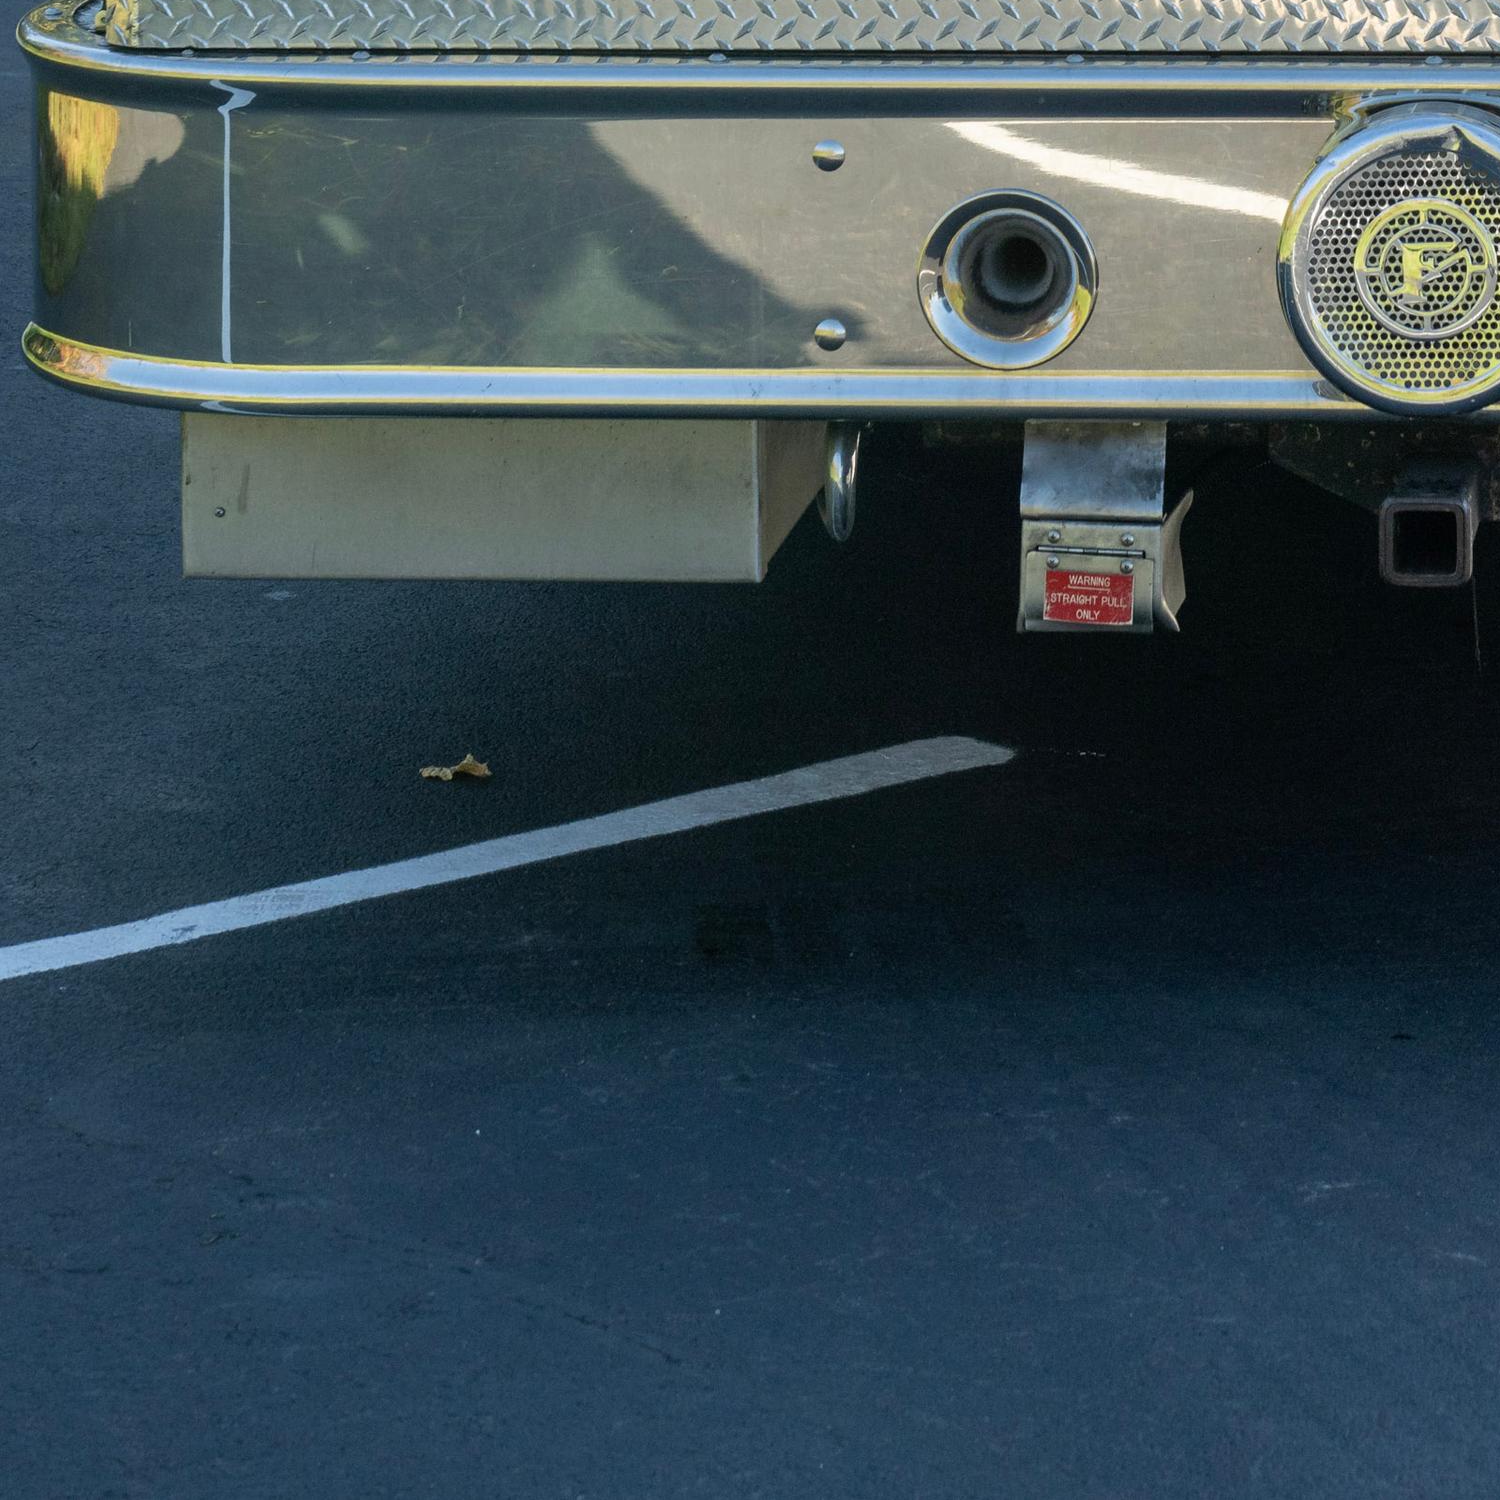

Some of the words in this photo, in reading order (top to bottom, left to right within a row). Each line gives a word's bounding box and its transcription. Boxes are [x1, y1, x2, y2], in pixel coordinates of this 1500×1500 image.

[1068, 574, 1111, 588] WARNING
[1050, 592, 1098, 605] STRAIGHT
[1101, 596, 1127, 608] PULL
[1075, 609, 1100, 620] ONLY
